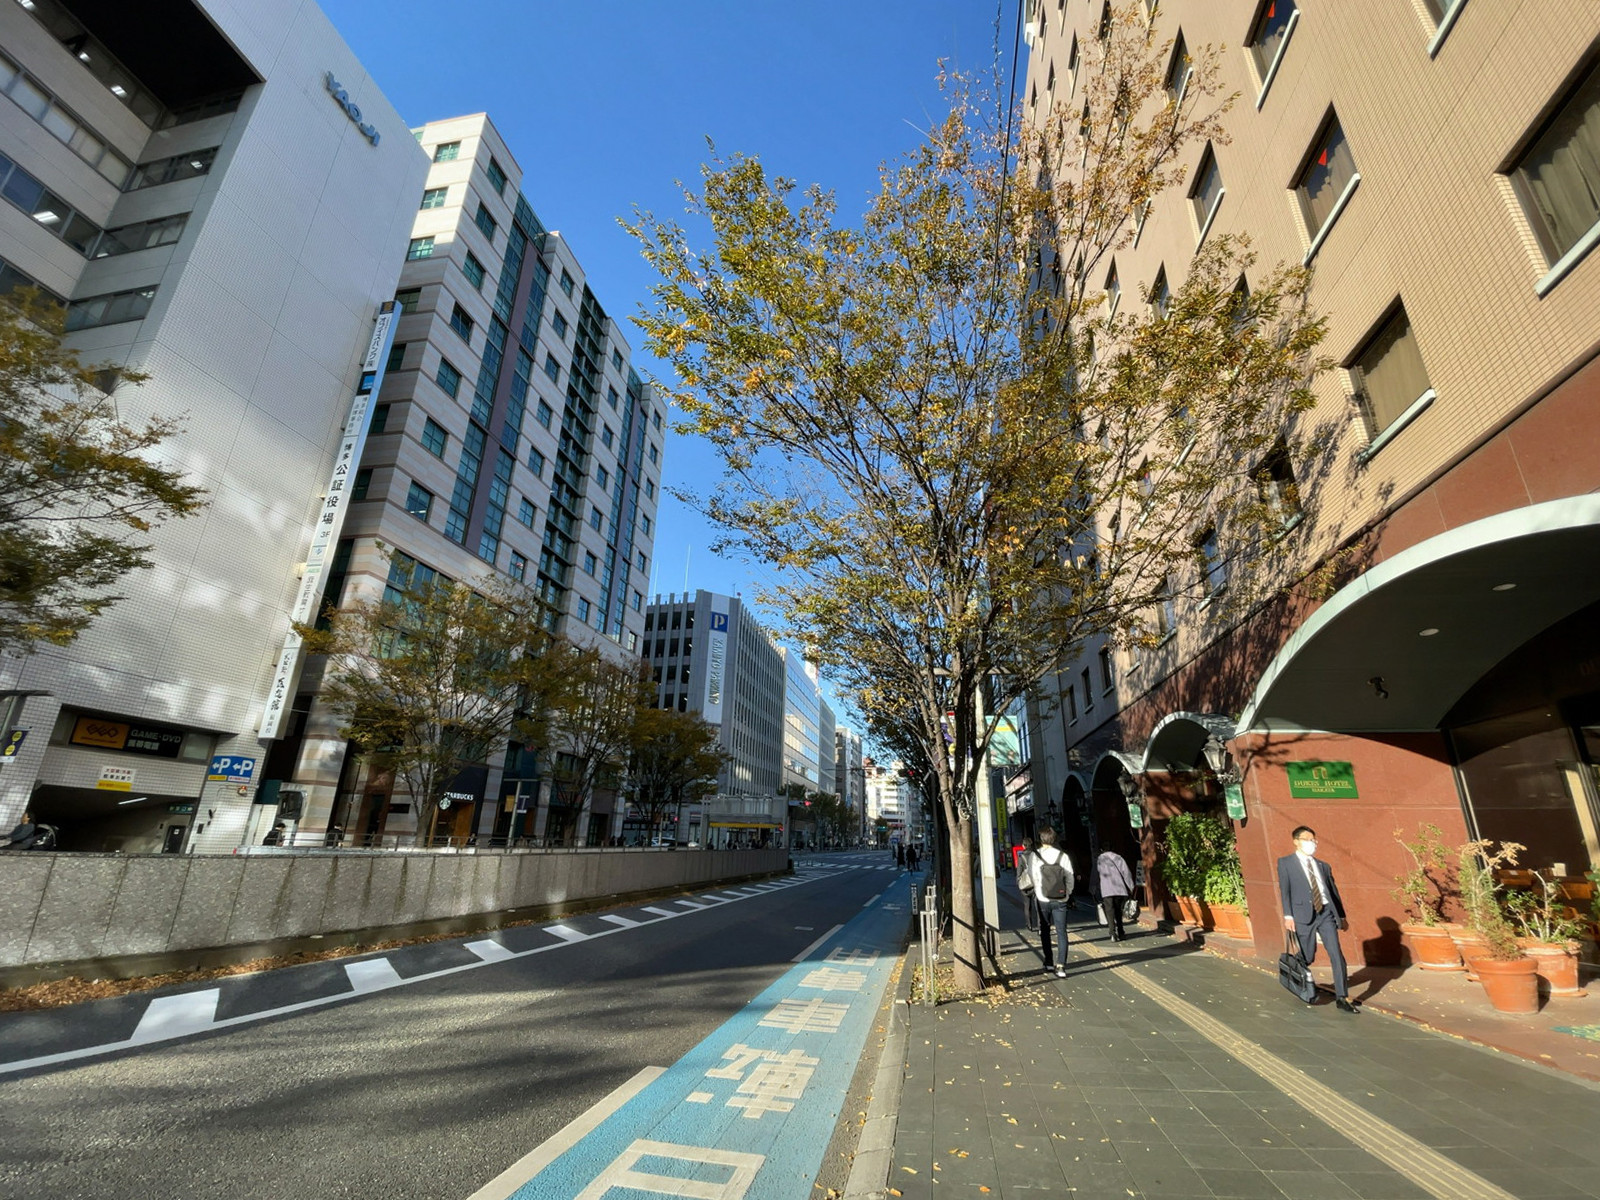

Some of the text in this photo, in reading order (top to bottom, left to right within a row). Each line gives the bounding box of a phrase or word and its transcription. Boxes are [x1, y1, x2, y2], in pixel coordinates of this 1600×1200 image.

[322, 443, 352, 525] 博多公証役場
[714, 614, 725, 629] P
[217, 758, 254, 775] P P
[1324, 780, 1350, 788] HOTEL
